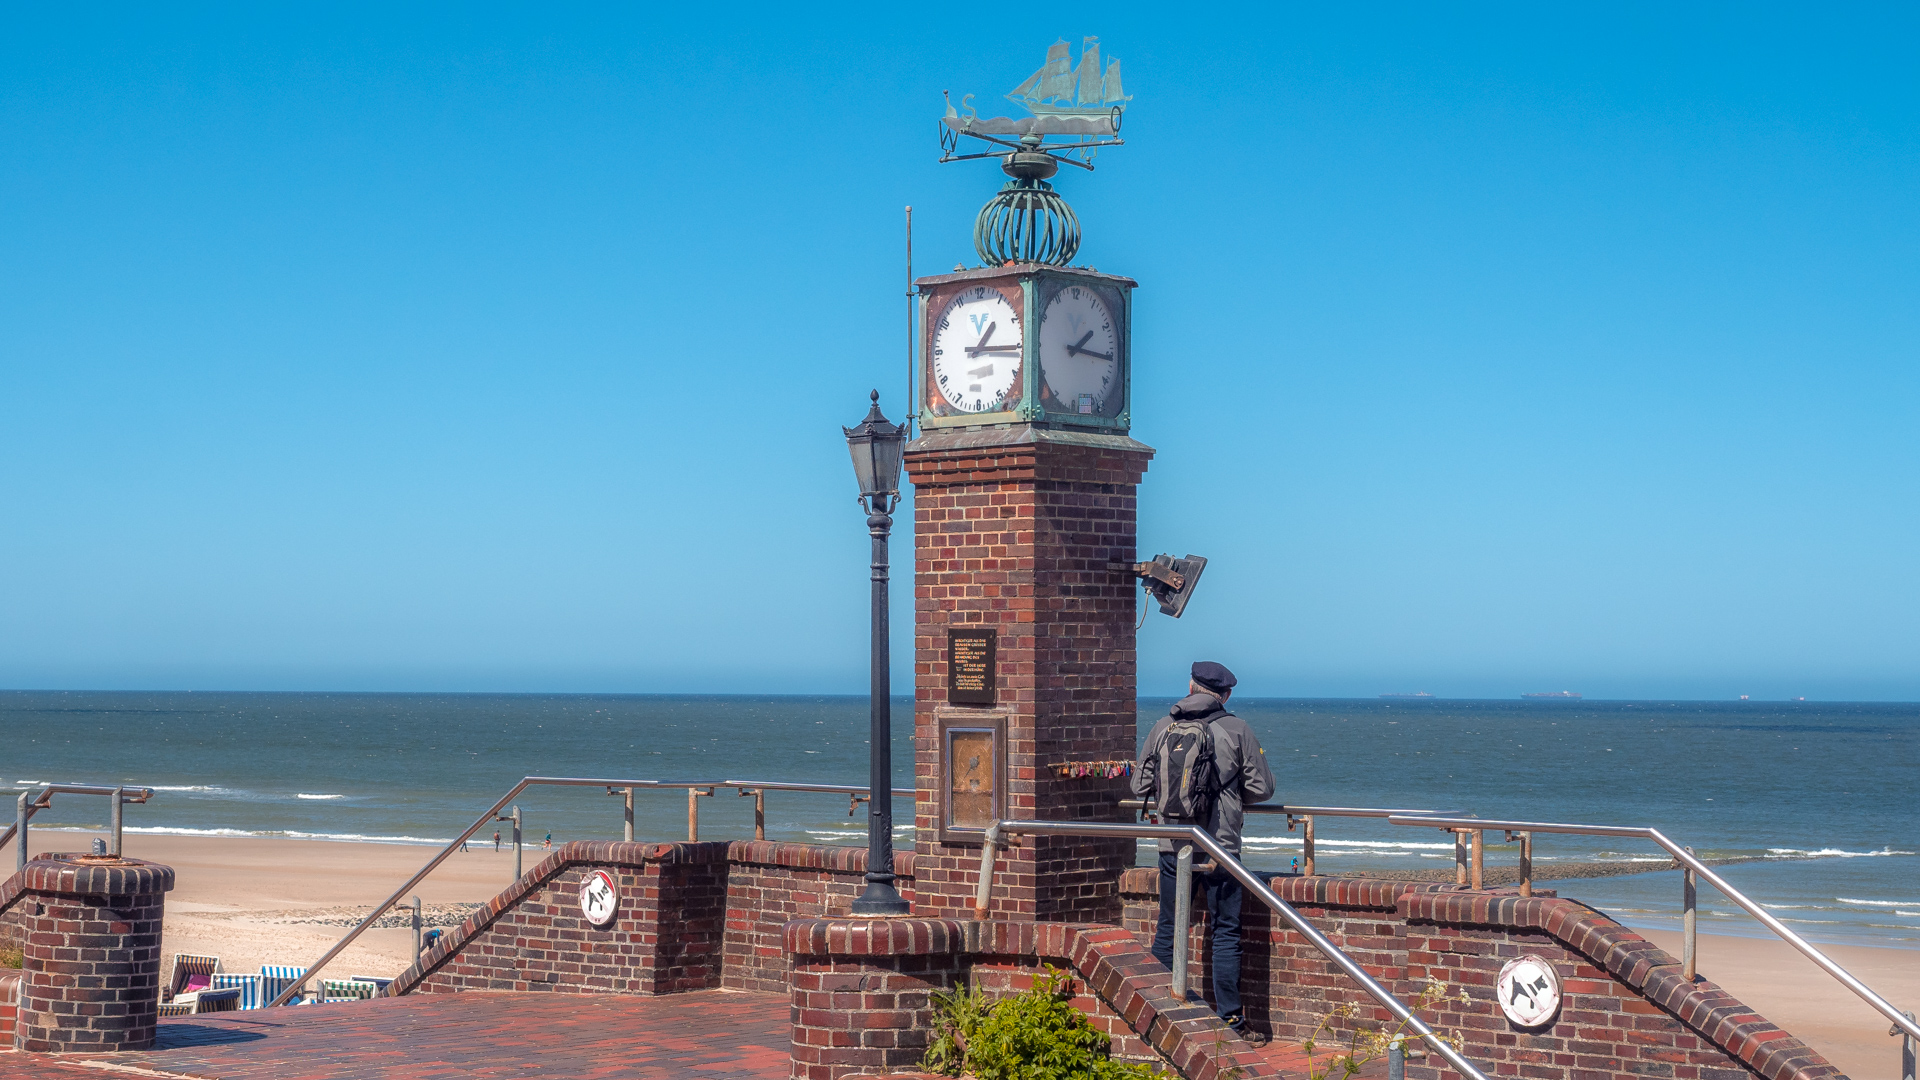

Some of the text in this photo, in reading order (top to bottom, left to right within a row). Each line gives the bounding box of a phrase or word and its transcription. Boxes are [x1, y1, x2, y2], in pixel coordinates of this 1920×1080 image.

[962, 93, 976, 123] S
[939, 120, 959, 152] W
[976, 287, 984, 299] 12
[1072, 288, 1080, 300] 12
[956, 296, 965, 308] 11
[997, 294, 1003, 304] 1
[1091, 299, 1096, 309] 1
[940, 319, 950, 330] 10
[1102, 322, 1110, 331] 2
[1011, 369, 1018, 379] 4
[940, 375, 948, 385] 8
[1102, 376, 1109, 385] 4
[955, 392, 963, 404] 7
[996, 390, 1003, 401] 5
[976, 399, 982, 411] 6
